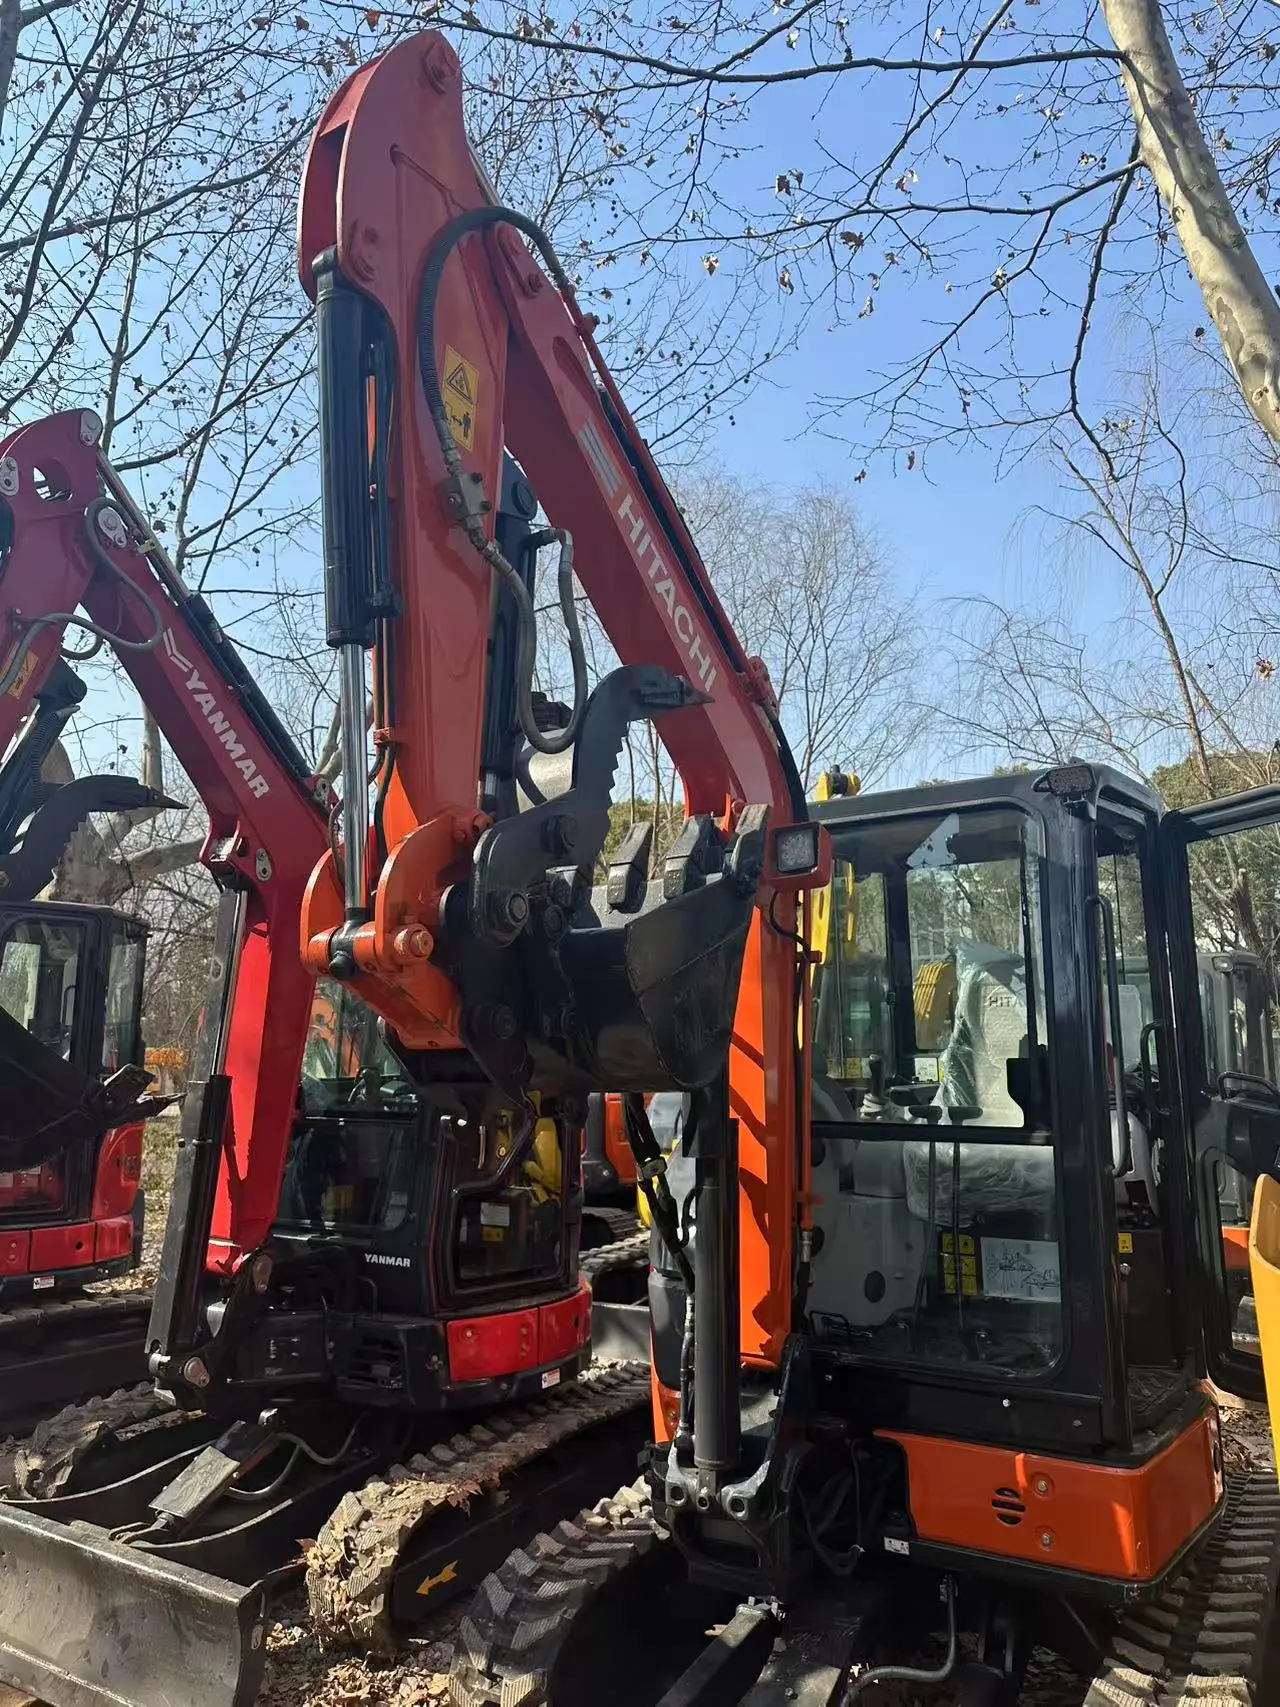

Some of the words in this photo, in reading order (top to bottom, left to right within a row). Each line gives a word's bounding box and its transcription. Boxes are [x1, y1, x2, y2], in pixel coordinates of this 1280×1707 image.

[618, 494, 717, 692] HITACHI
[185, 669, 270, 798] YANMAR
[988, 996, 1024, 1008] HITA
[364, 1252, 411, 1268] YANMAR
